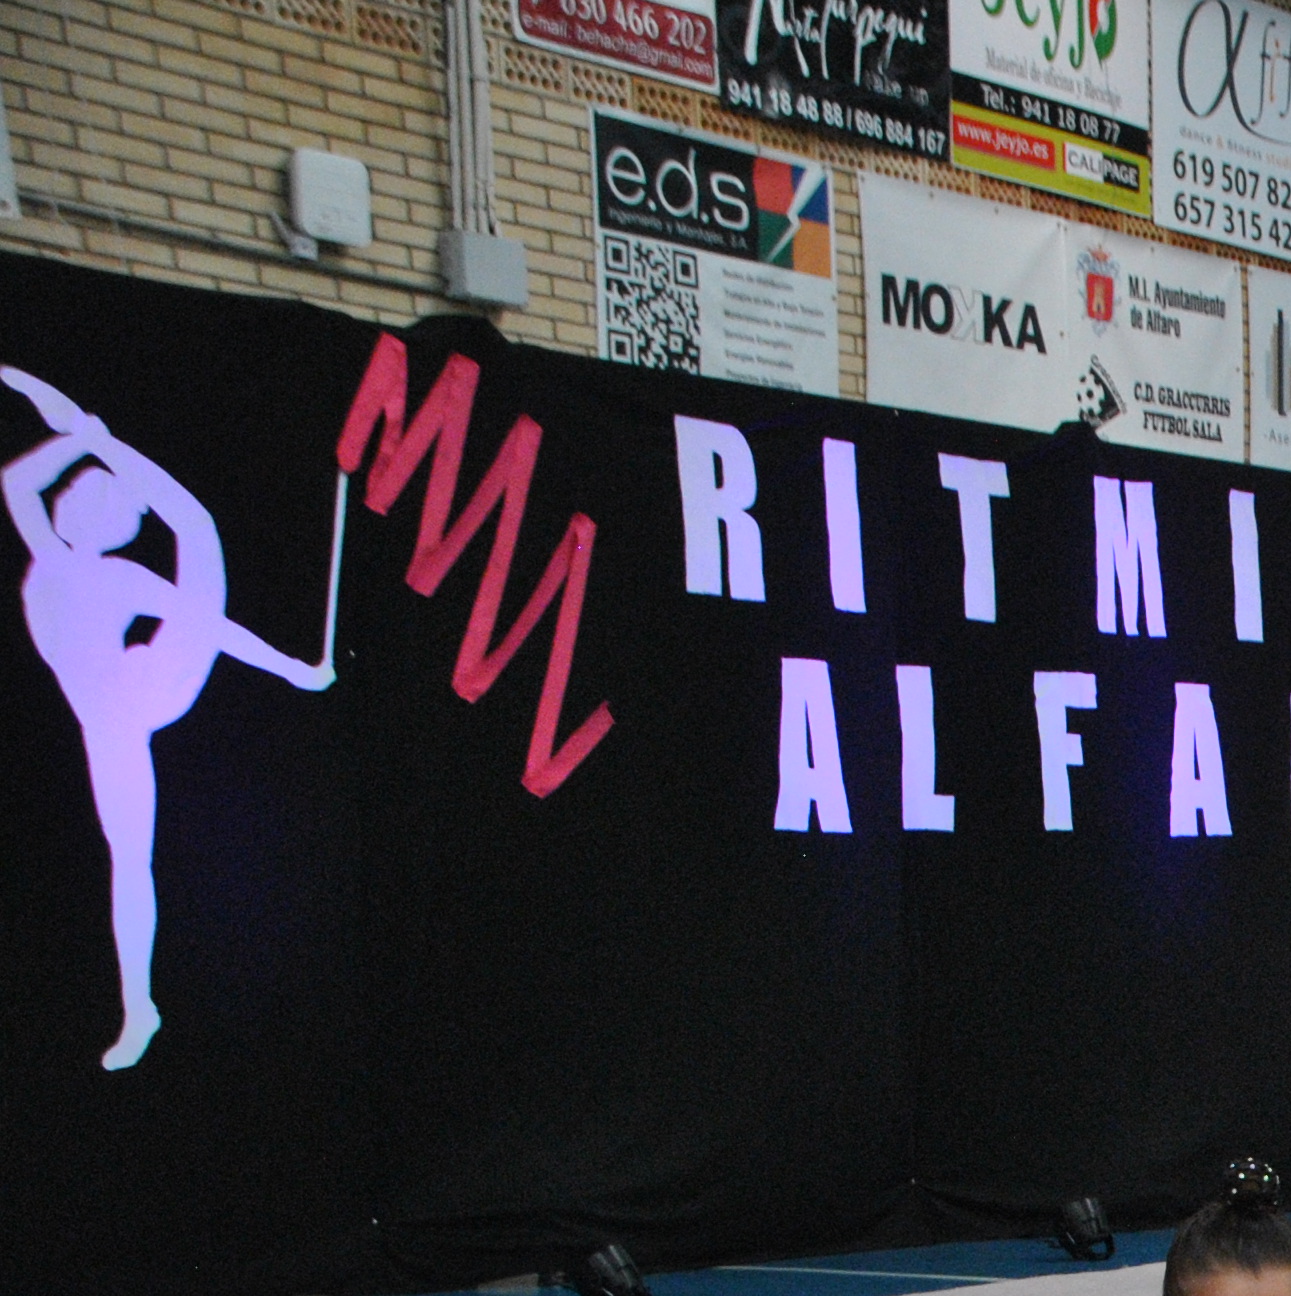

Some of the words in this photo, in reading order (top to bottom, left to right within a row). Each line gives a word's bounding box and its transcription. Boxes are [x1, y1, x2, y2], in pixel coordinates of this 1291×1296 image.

[522, 13, 571, 39] e-mail:
[612, 0, 660, 40] 466
[665, 13, 706, 55] 202
[727, 77, 762, 110] 941
[768, 85, 794, 117] 18
[796, 92, 820, 122] 48
[822, 100, 845, 129] 88
[854, 107, 884, 141] 696
[917, 126, 946, 155] 167
[980, 82, 1016, 114] Tel.:
[1021, 95, 1051, 126] 941
[1057, 106, 1077, 132] 18
[1079, 112, 1100, 139] 08
[1102, 119, 1121, 144] 77
[957, 122, 1050, 161] www.jeyjo.es
[605, 146, 750, 232] e.d.s
[1173, 150, 1215, 187] 619
[1221, 161, 1260, 201] 507
[1174, 192, 1215, 229] 657
[1222, 204, 1262, 242] 315
[1130, 304, 1143, 331] de
[1147, 308, 1181, 339] Alfaro
[1154, 280, 1226, 319] Ayuntamiento
[1158, 384, 1231, 418] GRACCURRIS
[1143, 410, 1191, 437] FUTBOL
[1192, 420, 1223, 443] SALA
